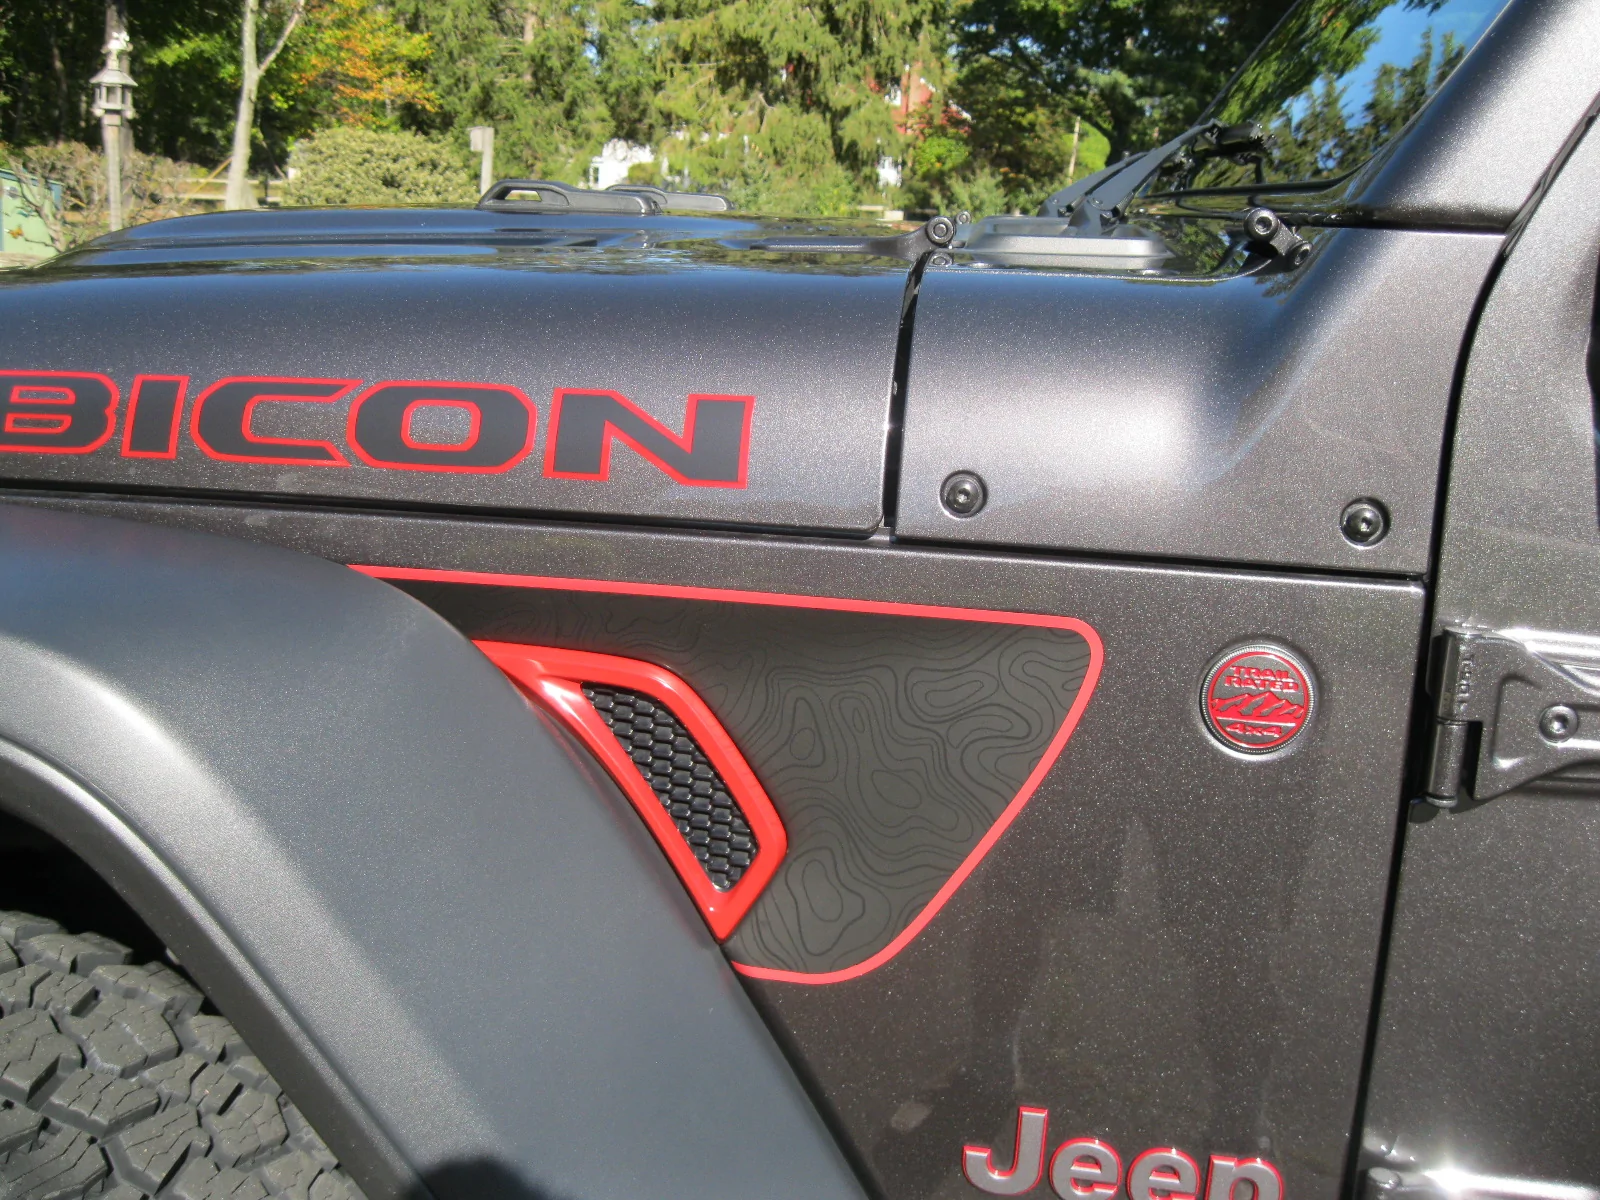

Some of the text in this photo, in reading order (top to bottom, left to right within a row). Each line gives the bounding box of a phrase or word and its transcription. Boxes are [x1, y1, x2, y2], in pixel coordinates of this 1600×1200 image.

[0, 370, 755, 489] BICON
[1230, 666, 1294, 682] TRAIL
[1224, 676, 1299, 692] RATED
